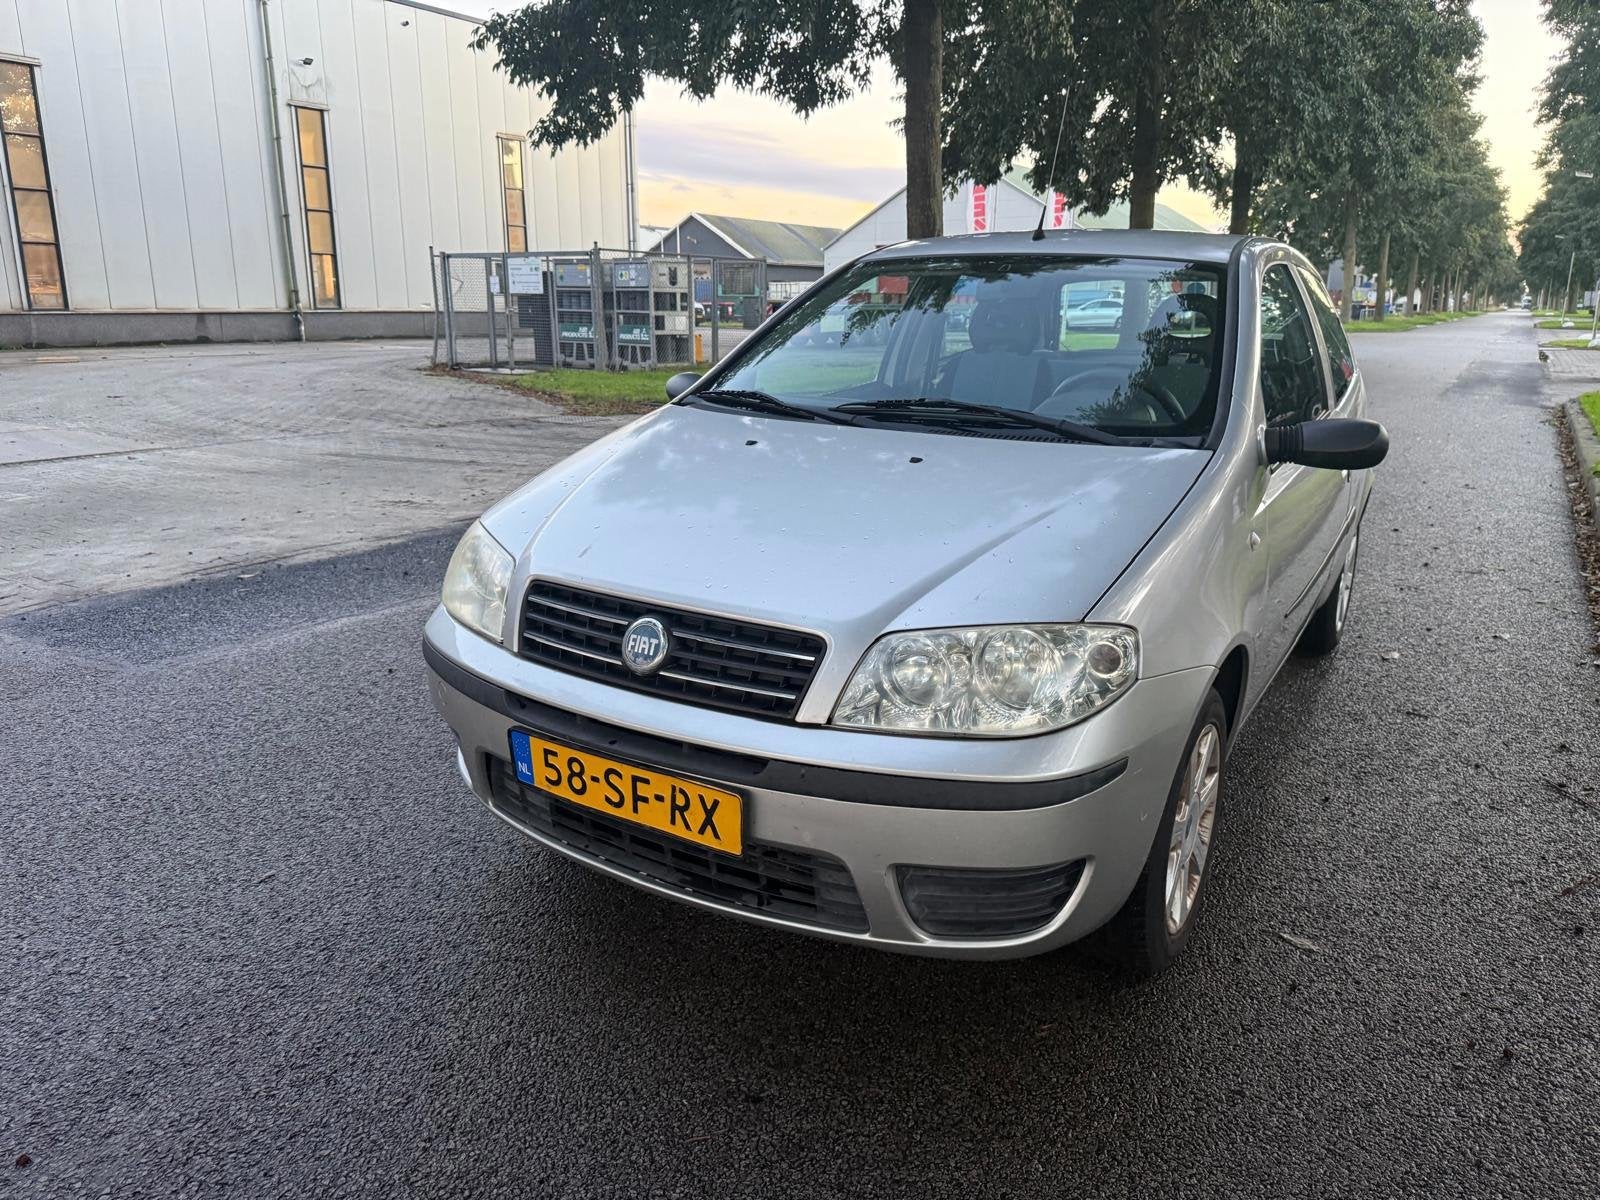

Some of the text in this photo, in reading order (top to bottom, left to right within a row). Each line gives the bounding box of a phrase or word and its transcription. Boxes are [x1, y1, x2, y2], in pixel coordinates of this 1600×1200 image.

[627, 634, 660, 656] FIAT
[518, 762, 532, 776] NL
[542, 748, 722, 840] 58-SF-RX
